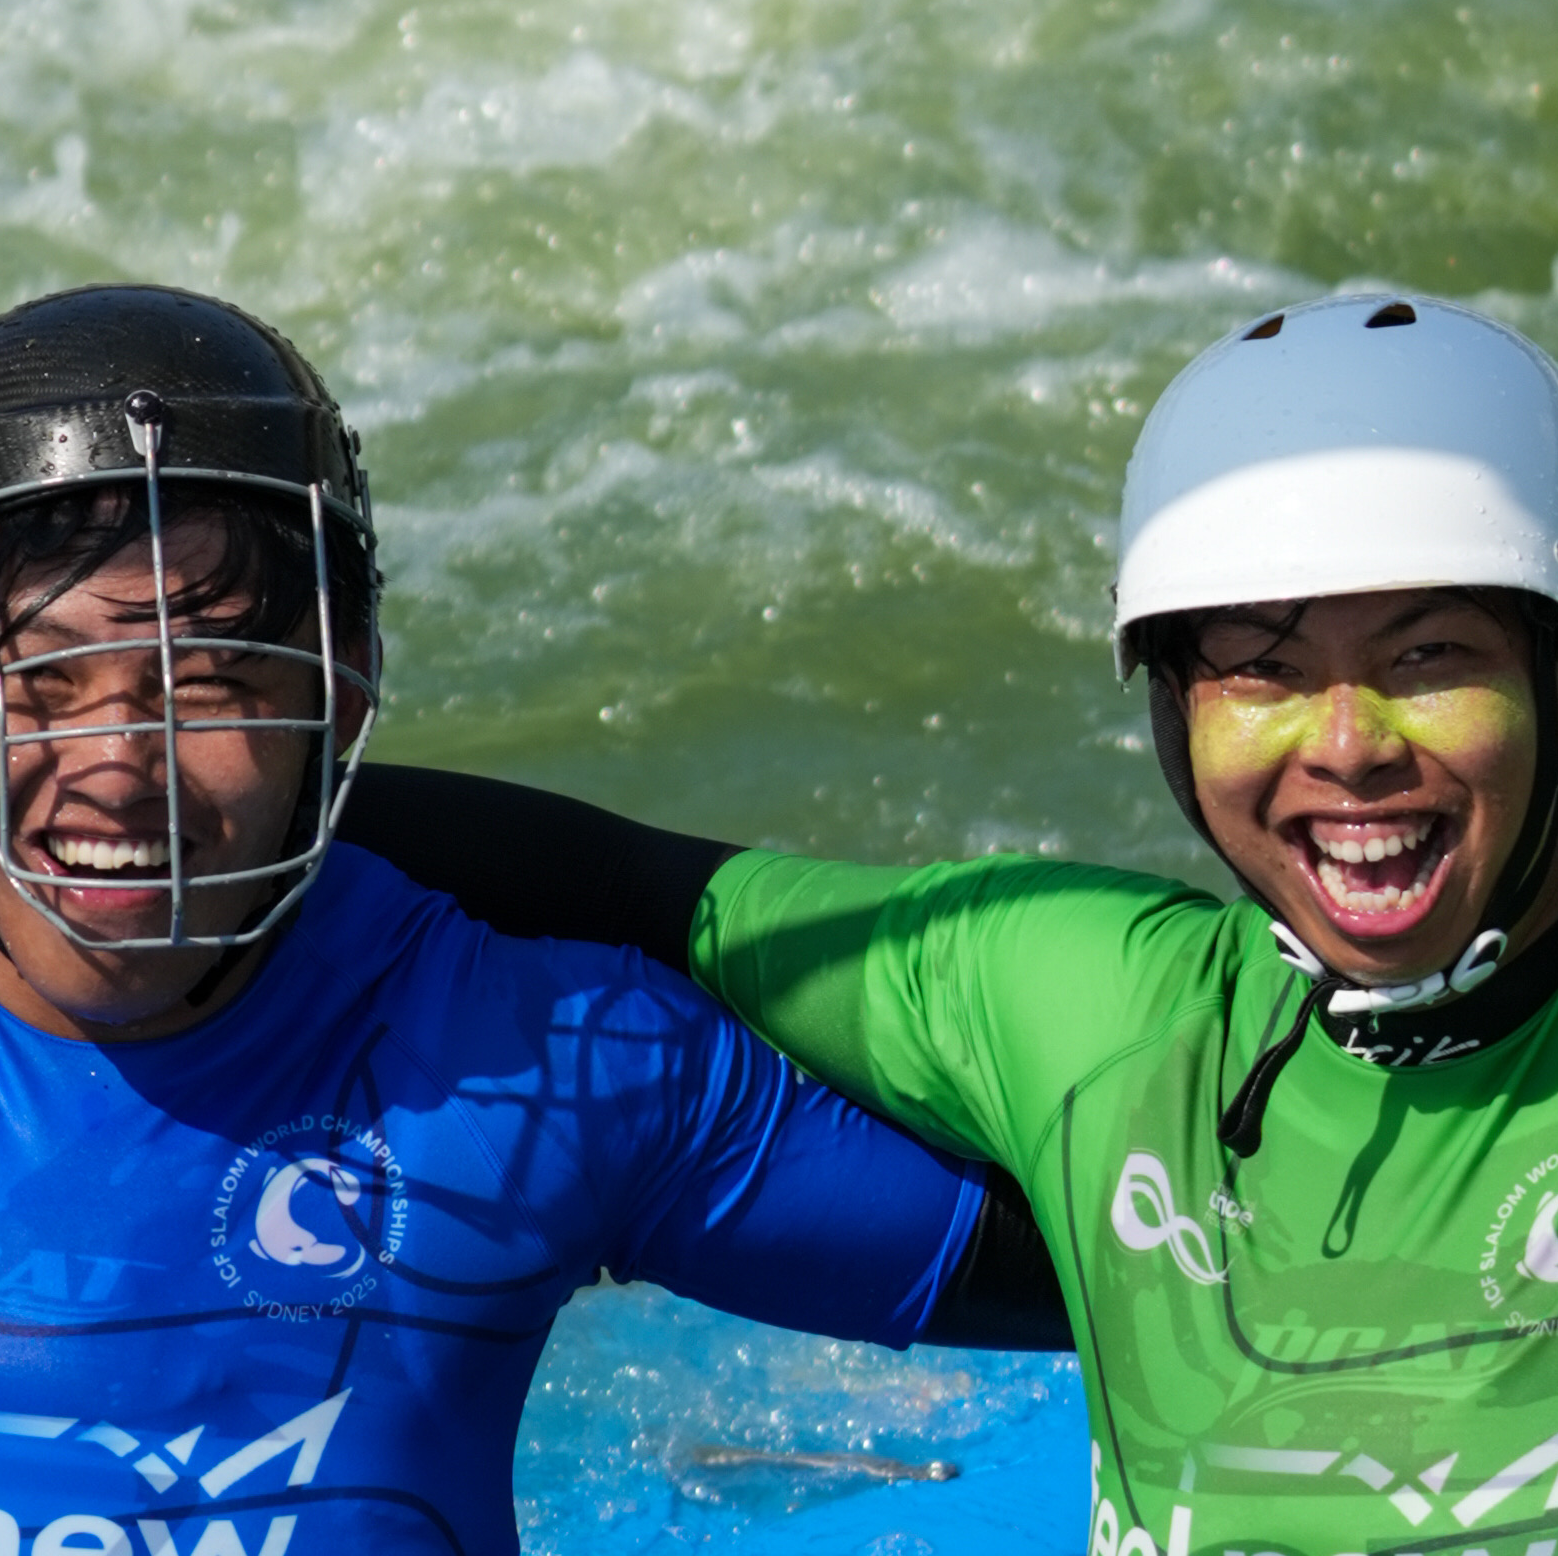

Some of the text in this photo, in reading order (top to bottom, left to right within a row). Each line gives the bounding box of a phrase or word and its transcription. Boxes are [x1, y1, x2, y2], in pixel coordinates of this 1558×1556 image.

[211, 1114, 409, 1288] ICF SLALOM WORLD CHAMPIONSHIPS
[1479, 1184, 1527, 1271] SLALOM
[243, 1273, 378, 1324] SYDNEY 2025
[1480, 1275, 1505, 1310] ICF
